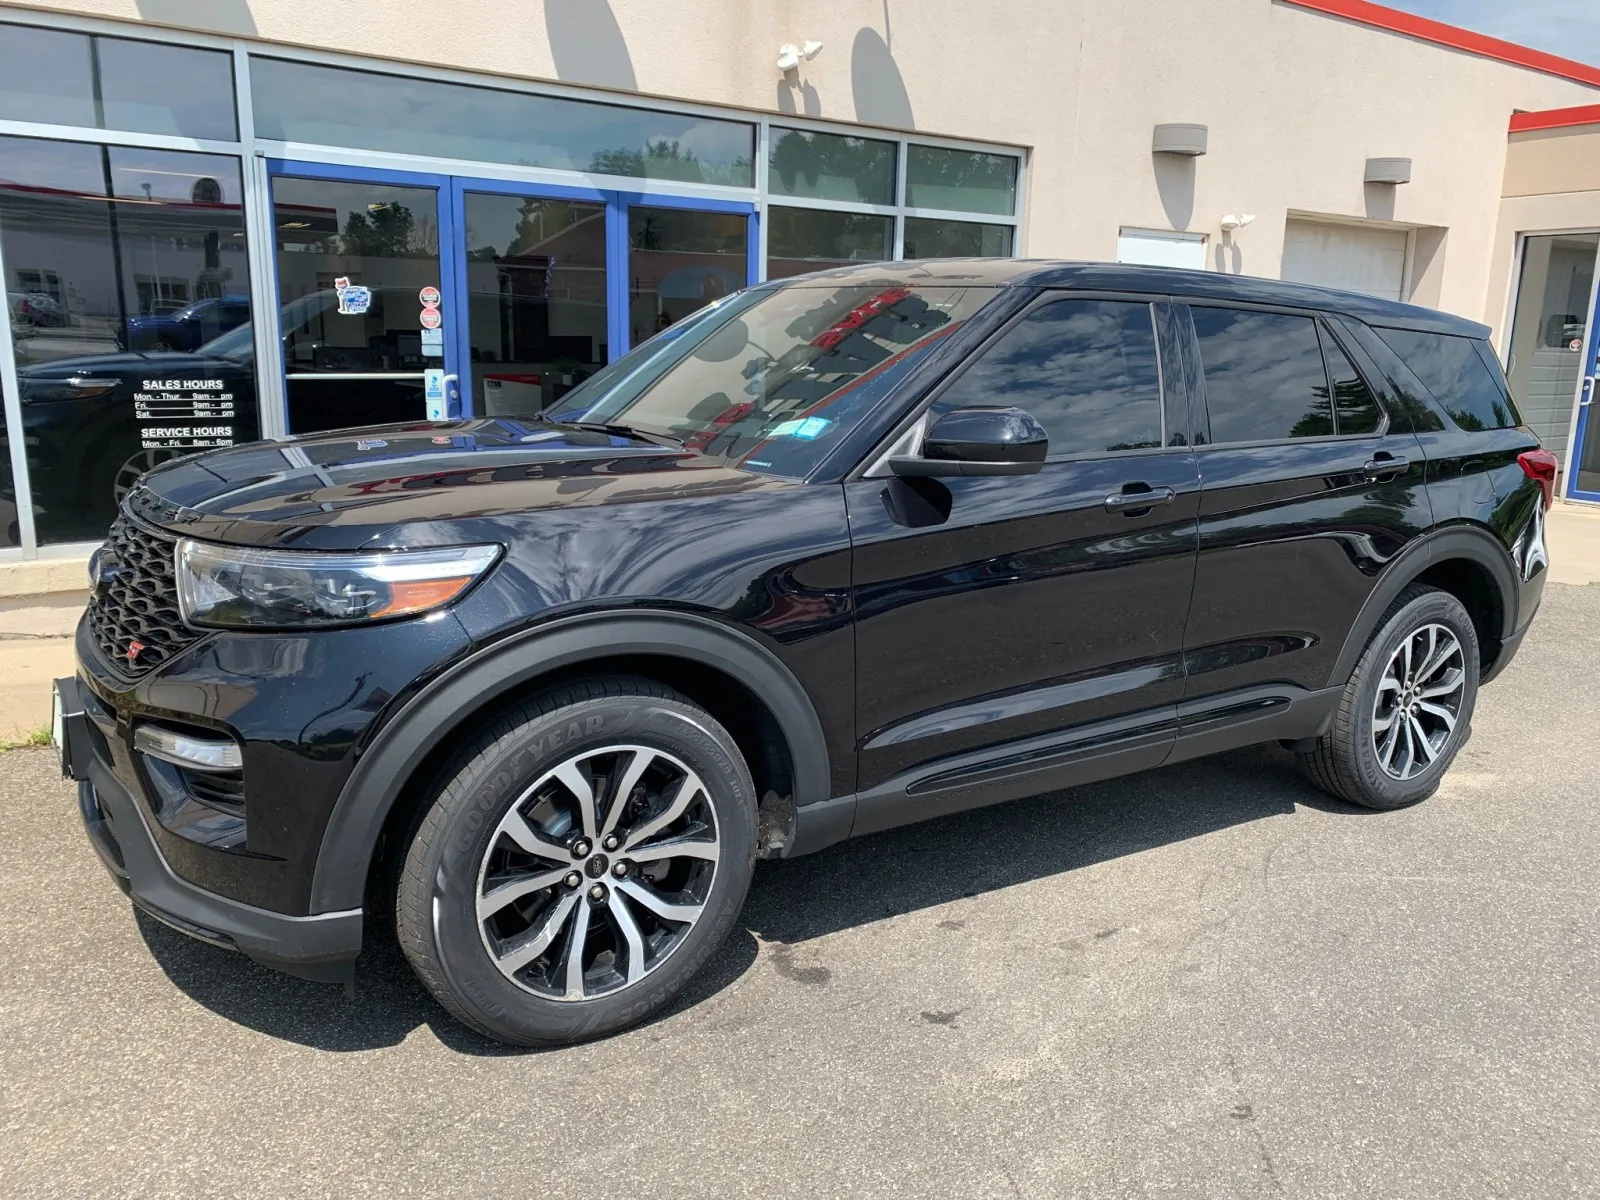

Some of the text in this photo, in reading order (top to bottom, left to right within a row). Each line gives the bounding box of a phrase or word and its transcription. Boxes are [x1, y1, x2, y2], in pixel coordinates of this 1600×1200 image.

[142, 380, 224, 390] SALES HOURS
[134, 393, 154, 401] Mon.
[161, 393, 181, 401] Thur.
[192, 392, 210, 400] 9am
[135, 402, 149, 410] Fri.
[192, 401, 210, 409] 9am
[136, 410, 152, 419] Sat.
[193, 410, 211, 418] 9am
[141, 426, 233, 438] SERVICE HOURS
[142, 440, 162, 449] Mon.
[169, 439, 182, 448] Fri.
[192, 439, 210, 447] 8am
[126, 640, 145, 659] ST
[455, 714, 604, 853] GOODYEAR
[617, 896, 737, 1021] ASSURANCE
